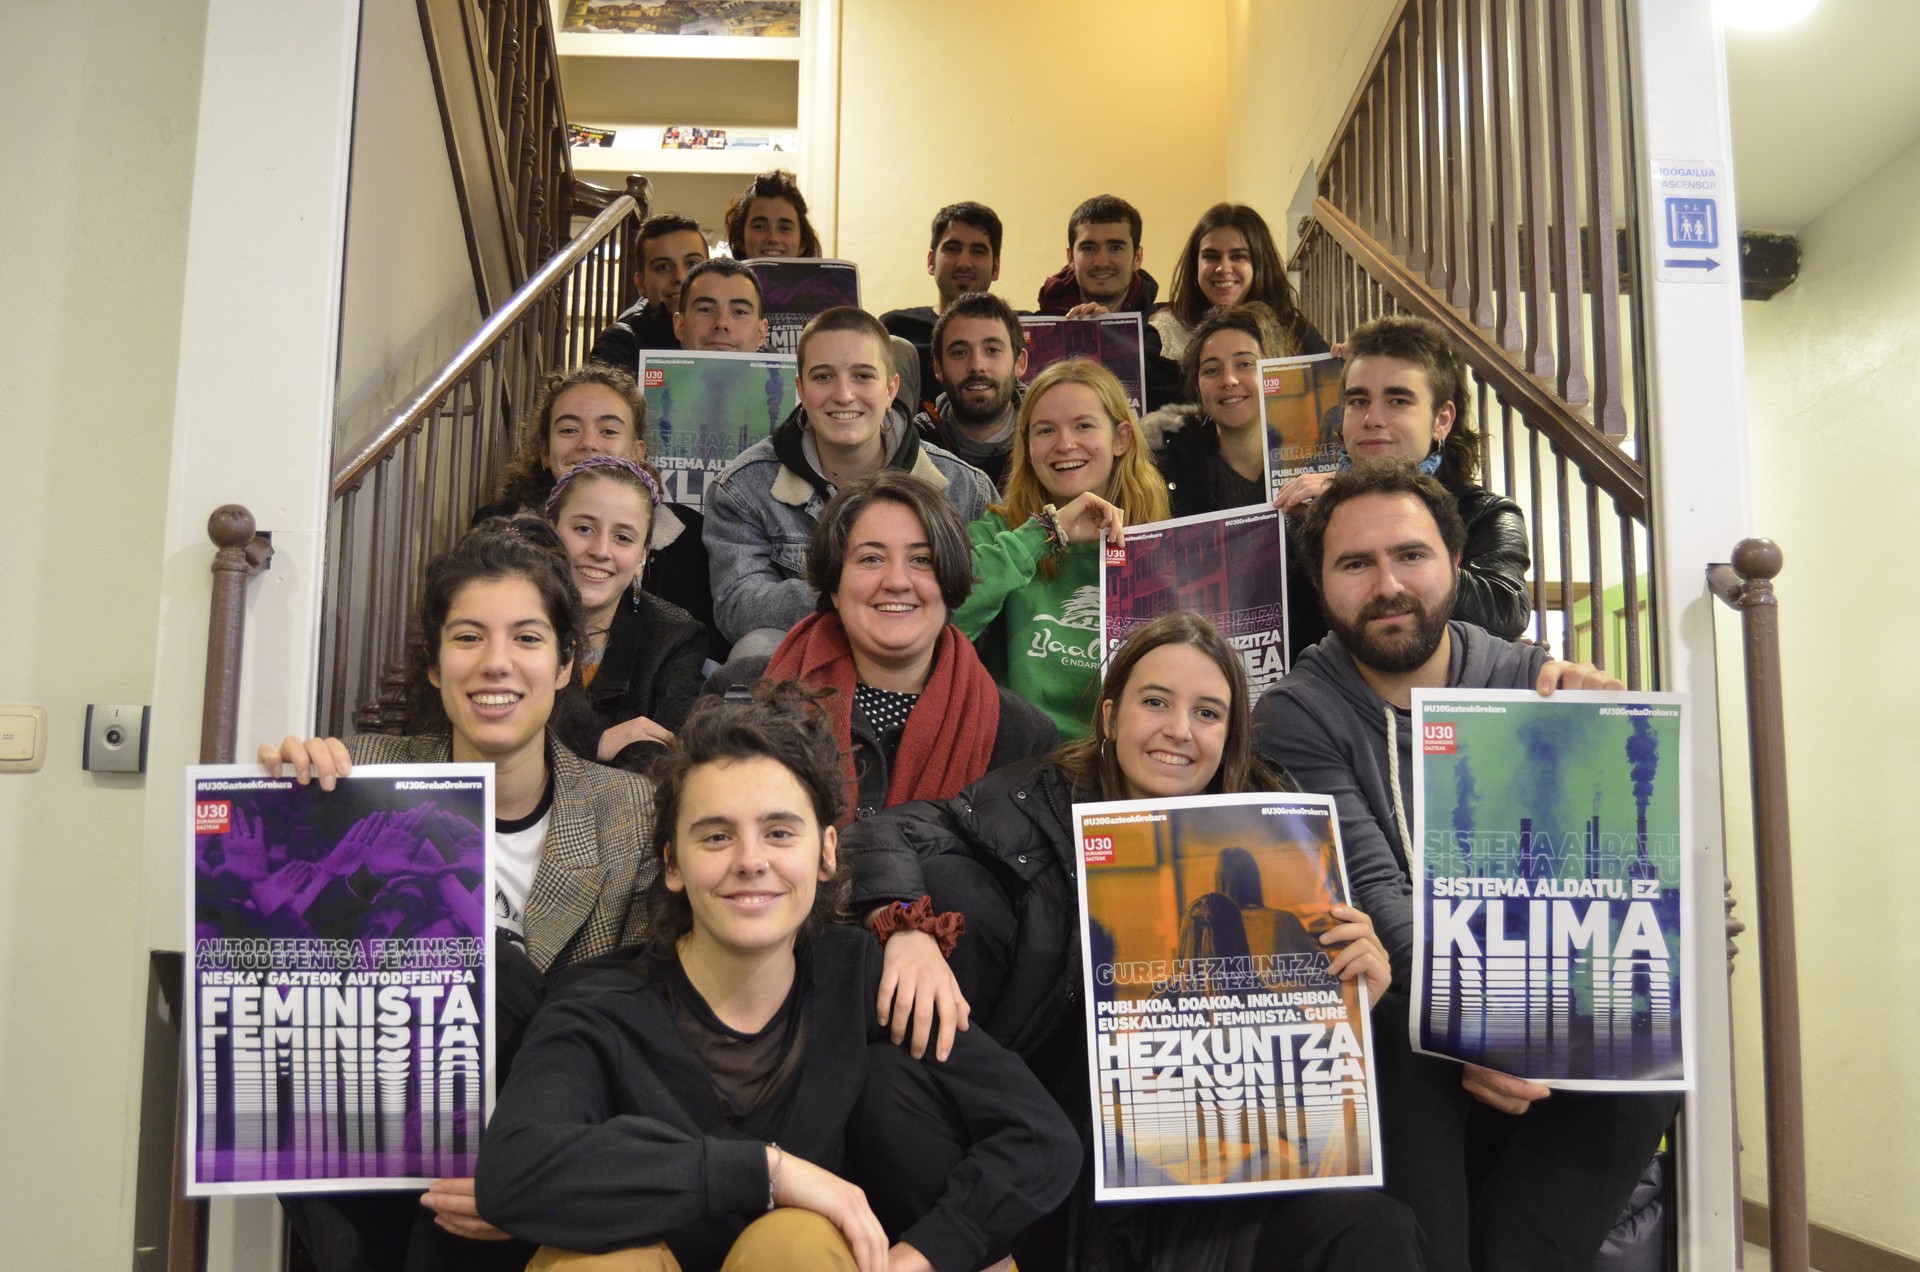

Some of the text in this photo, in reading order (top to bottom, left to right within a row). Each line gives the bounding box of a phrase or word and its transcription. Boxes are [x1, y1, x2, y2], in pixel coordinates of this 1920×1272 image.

[1660, 168, 1716, 177] IGOGAILUA
[1662, 181, 1716, 190] ASCENSOR
[646, 371, 663, 379] U30
[1264, 378, 1280, 387] U30
[1106, 549, 1126, 558] U30
[1424, 705, 1506, 713] #U30GazteokGrebara
[1599, 708, 1678, 717] #U30GrebaOrokorra
[1424, 726, 1453, 739] U30
[197, 781, 293, 791] #U30GazteokGrebara
[395, 781, 483, 790] #U30GrebaOrokorra
[197, 804, 229, 818] U30
[1261, 807, 1329, 816] #U30GrebaOrokorra
[1083, 813, 1168, 826] #U30GazteokGrebara
[1084, 837, 1113, 851] U30
[1432, 877, 1660, 900] SISTEMA ALDATU, EZ
[1432, 899, 1670, 958] KLIMA
[195, 937, 486, 957] AUTODEFENTSA FEMINISTA
[197, 949, 485, 970] AUTODEFENTSA FEMINISTA
[267, 971, 342, 985] GAZTEOK
[346, 970, 476, 985] AUTODEFENTSA
[1095, 960, 1167, 986] GURE
[202, 985, 480, 1027] FEMINISTA
[1097, 990, 1344, 1016] PUBLIKOA, DOAKOA, INKLUSIBOA,
[1098, 1005, 1348, 1032] EUSKALDUNA, FEMINISTA: GURE
[1098, 1022, 1364, 1069] HEZKUNTZA
